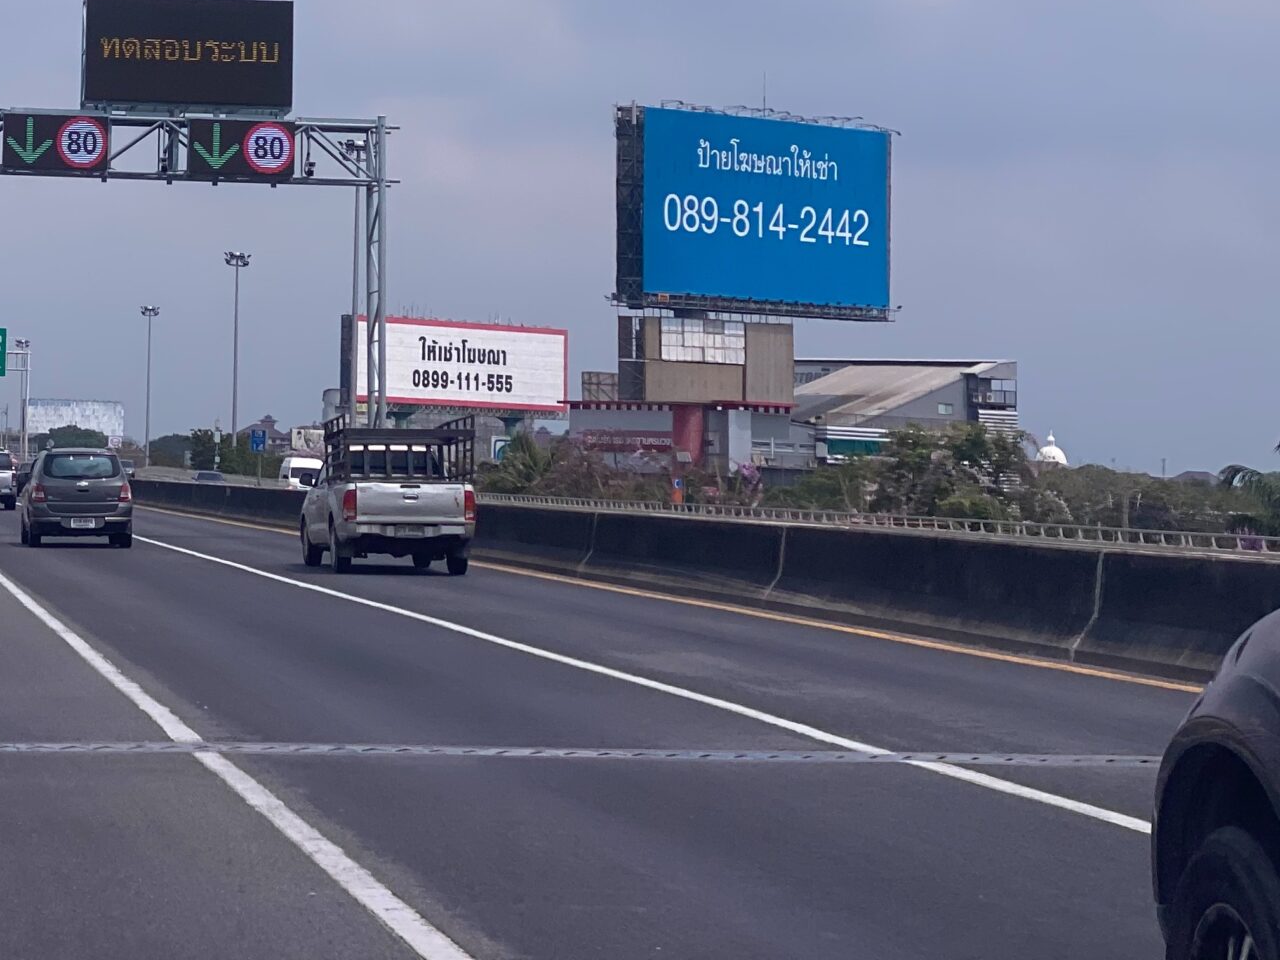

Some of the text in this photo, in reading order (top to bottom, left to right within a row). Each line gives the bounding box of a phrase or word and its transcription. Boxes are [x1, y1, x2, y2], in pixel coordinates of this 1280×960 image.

[100, 36, 279, 63] ทดสอบระบบ
[67, 130, 97, 155] 80
[254, 135, 284, 160] 80
[696, 138, 838, 181] ป้ายโฆษณาให้เช่า
[663, 193, 870, 246] 089-814-2442
[418, 336, 507, 366] ให้เช่าโฆษณา
[412, 369, 514, 393] 0899-111-555
